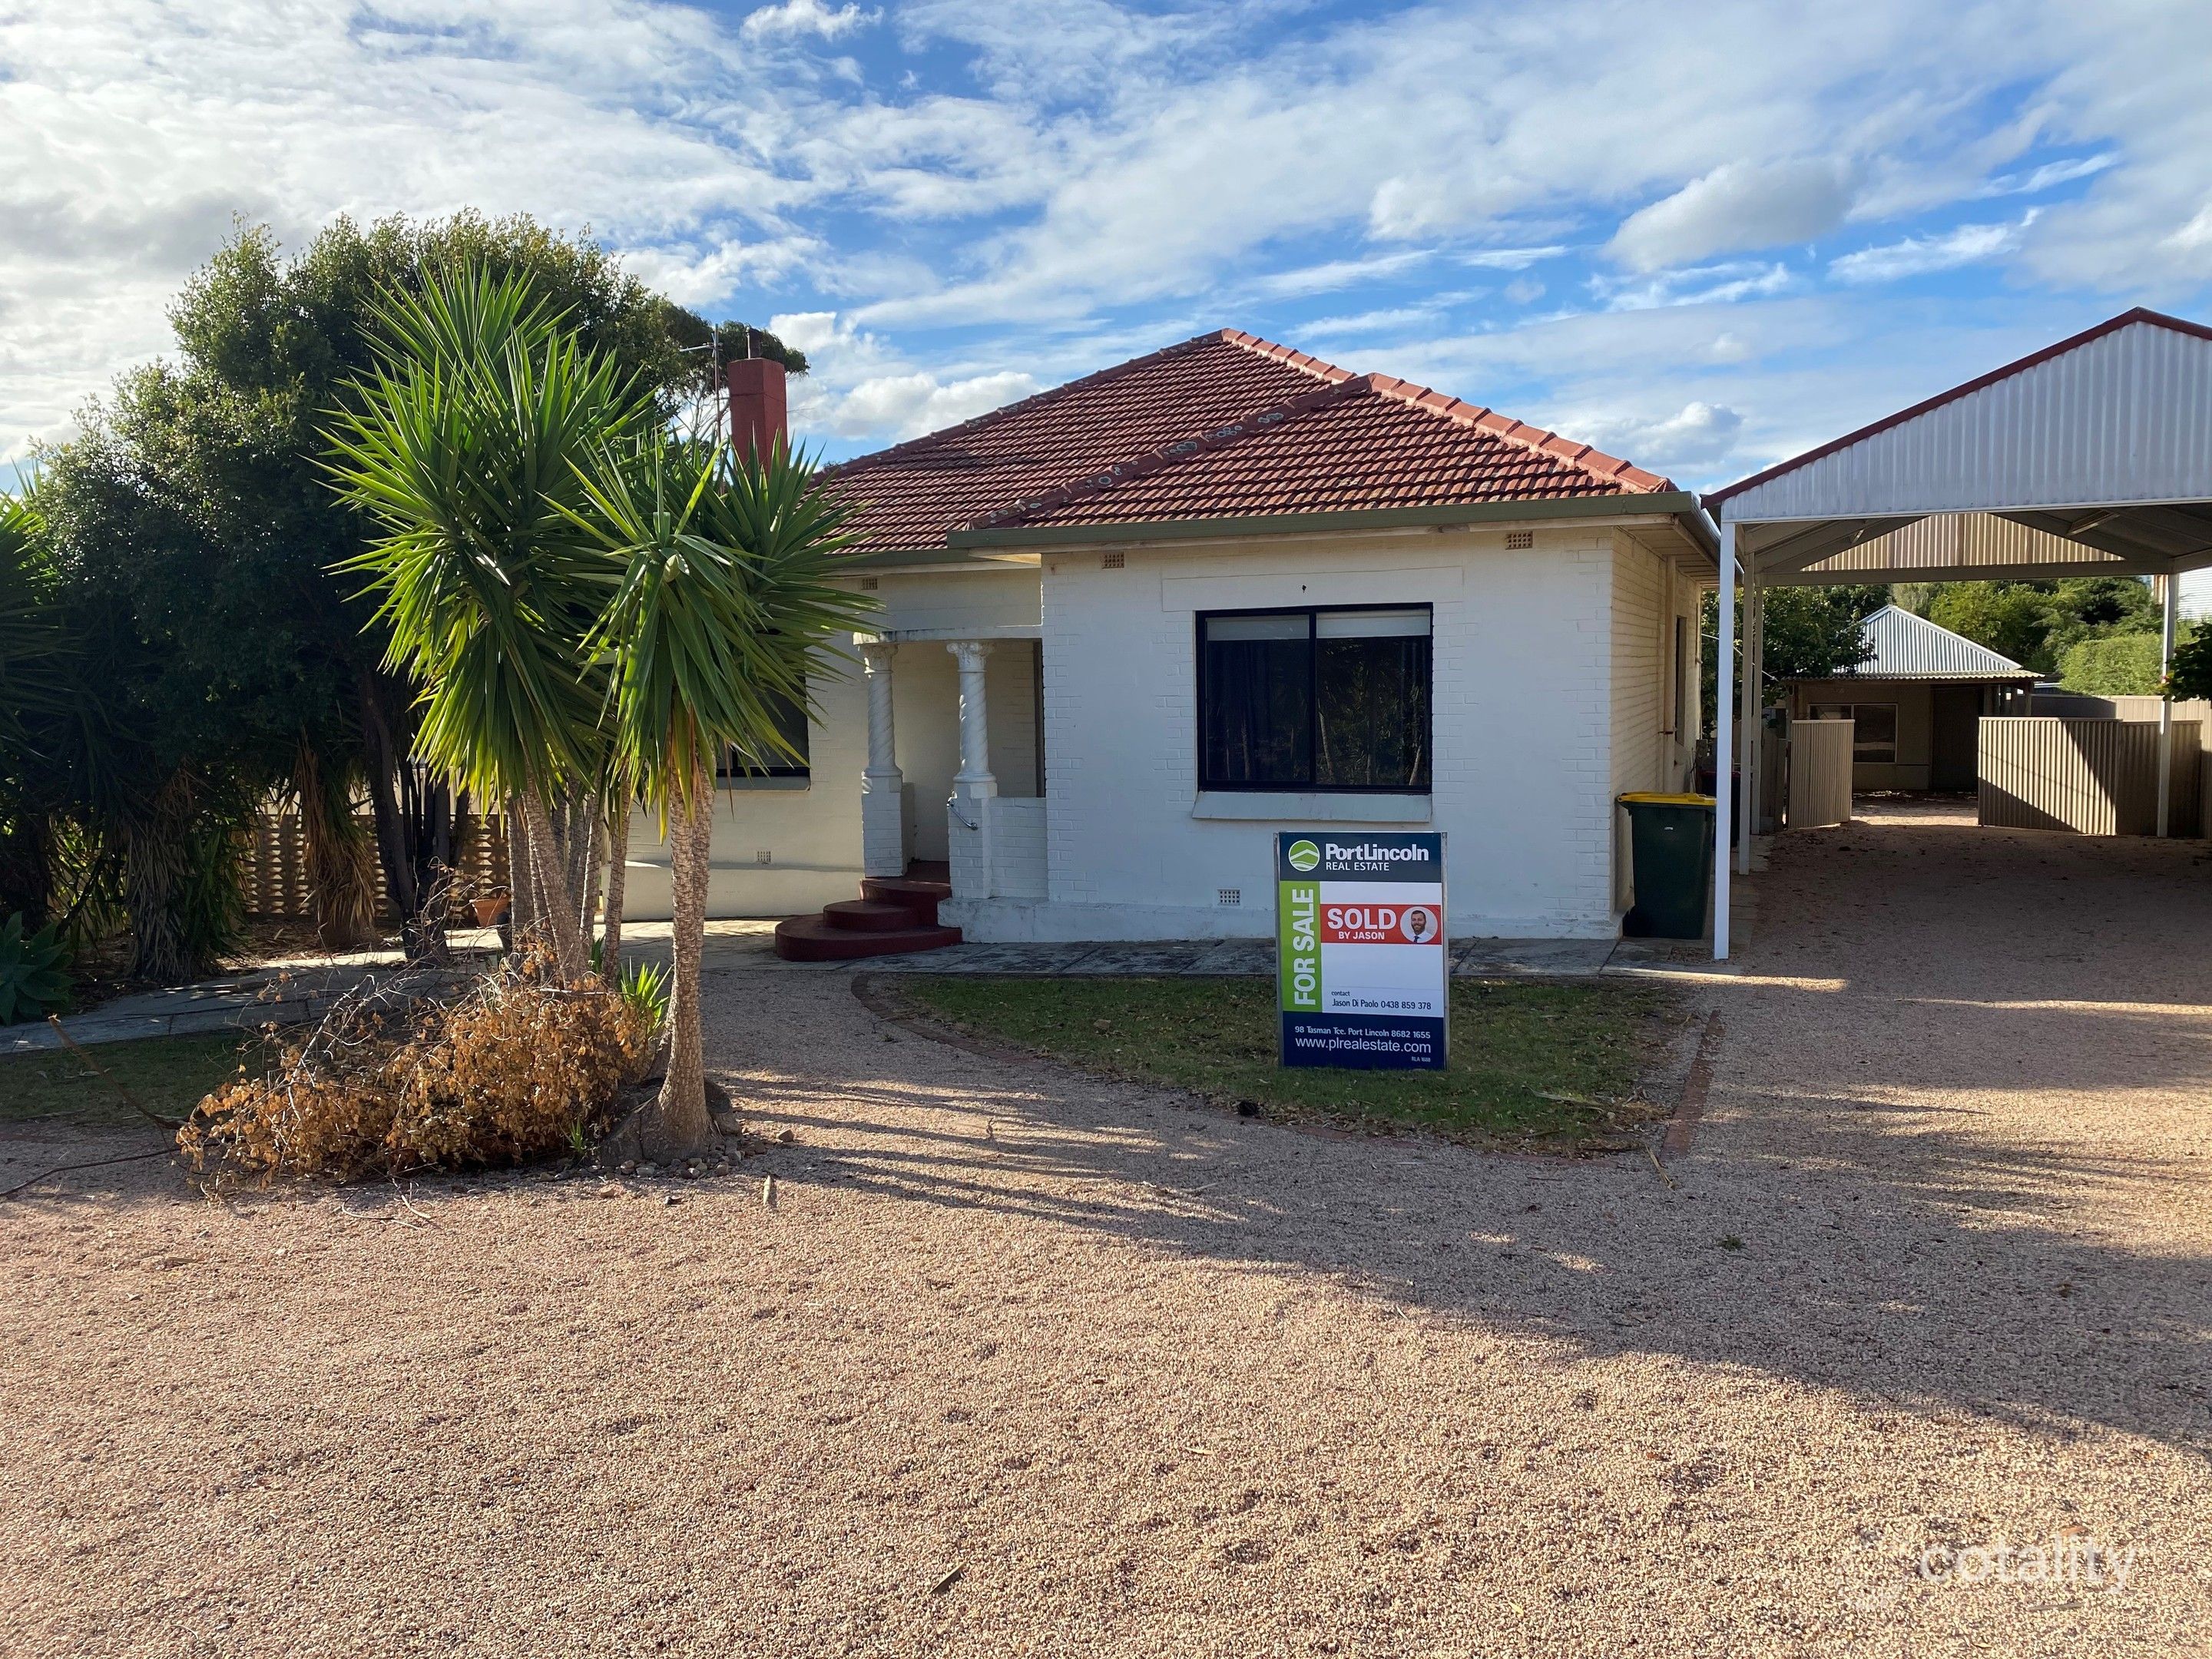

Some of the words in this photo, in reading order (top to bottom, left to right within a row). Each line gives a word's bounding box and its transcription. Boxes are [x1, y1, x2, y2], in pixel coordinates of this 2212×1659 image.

[1326, 862, 1350, 871] REAL
[1354, 862, 1389, 872] ESTATE
[1292, 889, 1314, 952] SALE
[1327, 908, 1397, 930] SOLD
[1353, 932, 1385, 940] JASON
[1293, 958, 1316, 1005] FOR
[1332, 998, 1350, 1007] Jason
[1361, 999, 1379, 1008] Paolo
[1306, 1026, 1331, 1035] Tasman
[1348, 1028, 1363, 1036] Port
[1296, 1037, 1431, 1053] www.plrealestate.com
